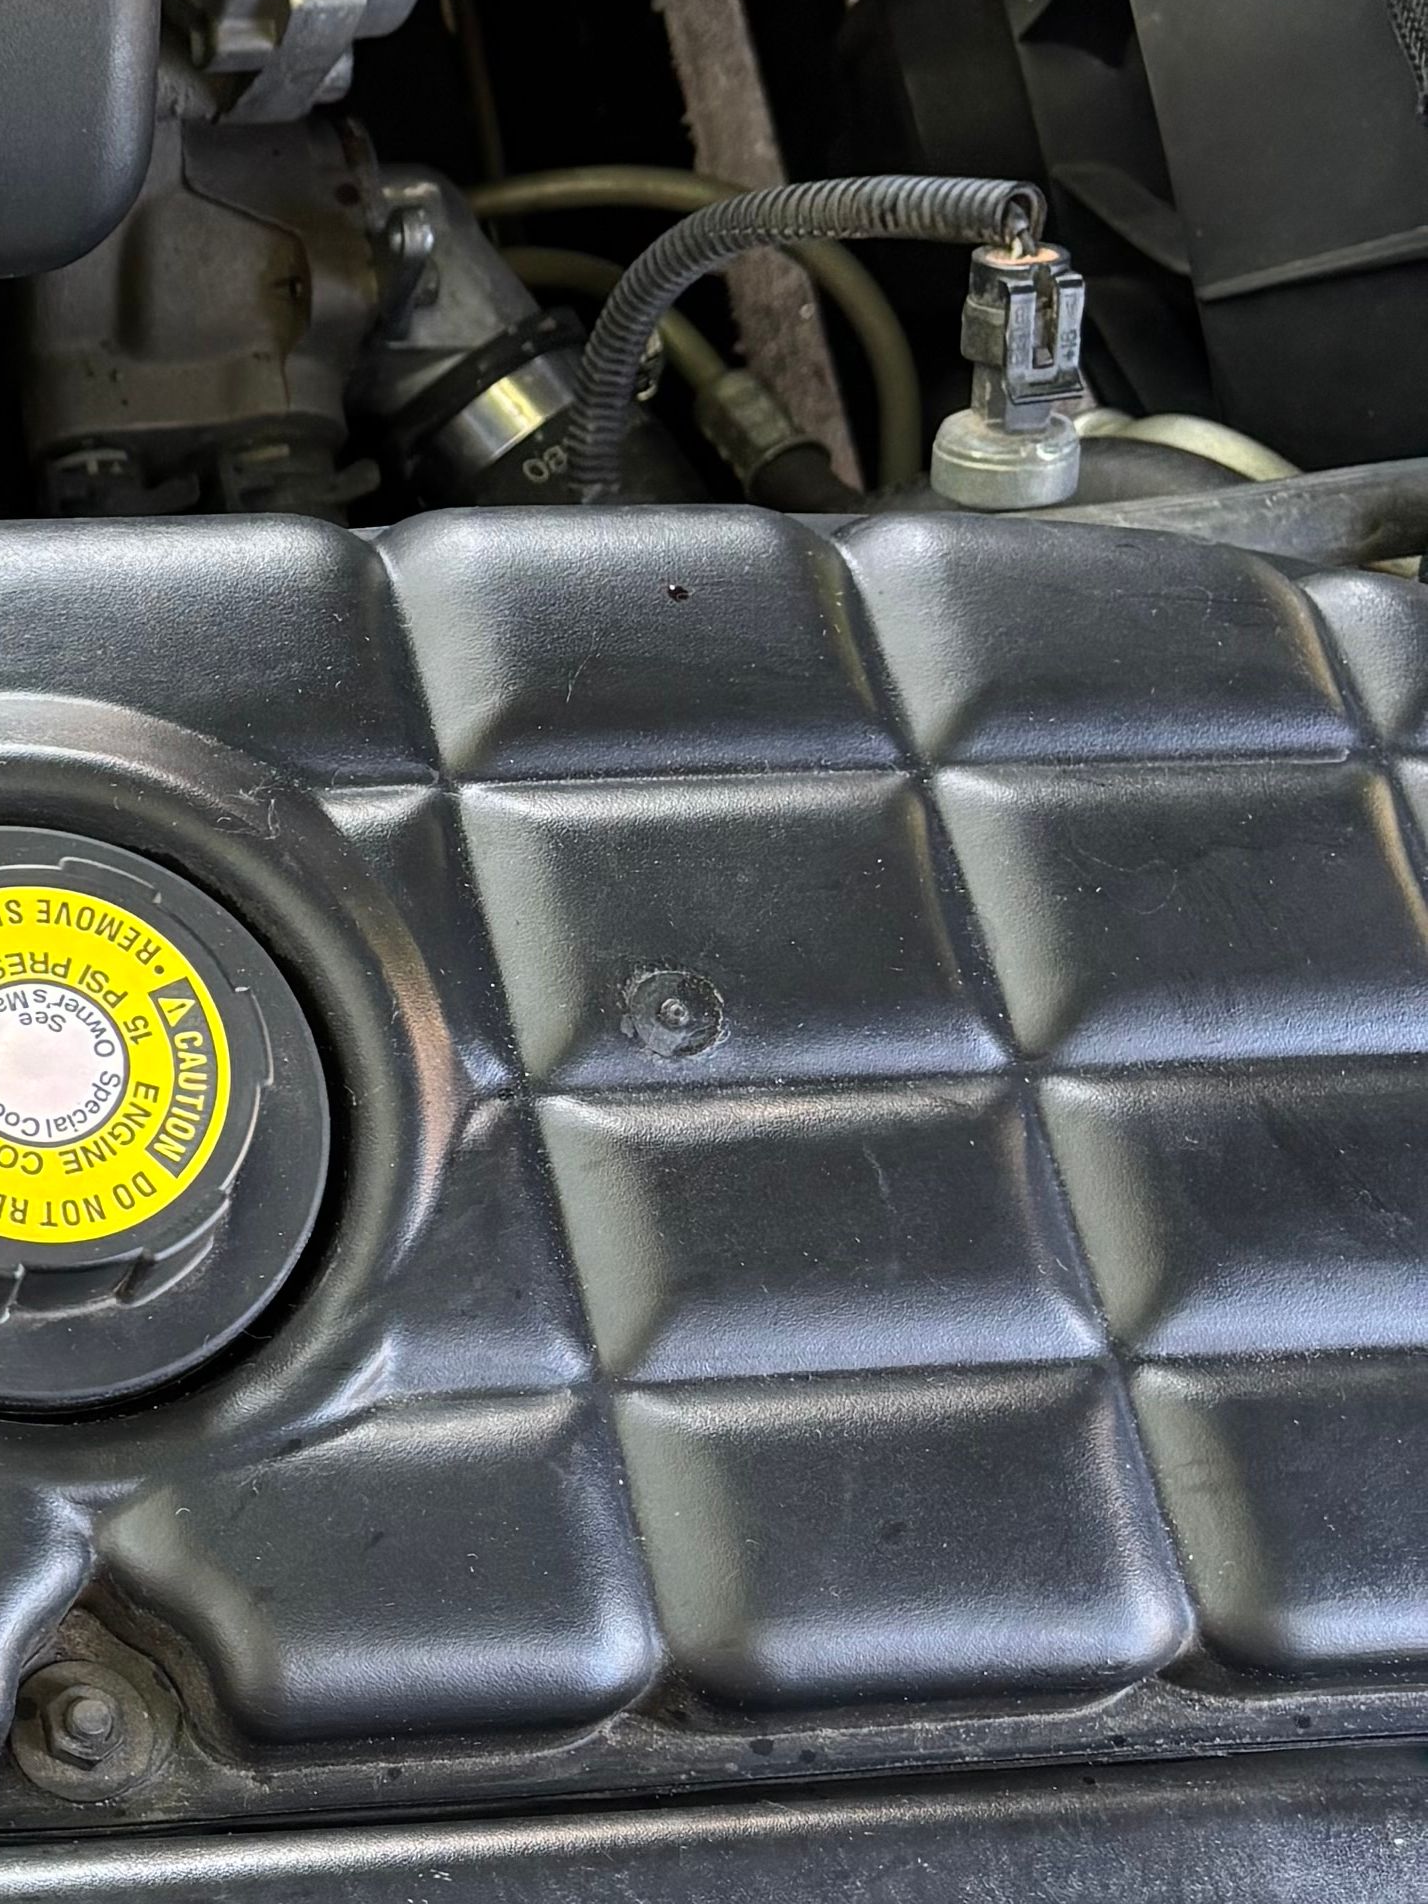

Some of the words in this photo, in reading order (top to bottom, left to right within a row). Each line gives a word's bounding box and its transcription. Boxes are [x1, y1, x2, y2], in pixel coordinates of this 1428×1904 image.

[36, 899, 163, 966] REMOVE
[77, 963, 129, 1009] PSI
[18, 1010, 68, 1033] See
[32, 988, 116, 1058] Owner's
[122, 1014, 153, 1045] 15
[45, 1070, 122, 1138] Special
[153, 1030, 208, 1163] CAUTION
[58, 1080, 161, 1175] ENGINE
[39, 1194, 107, 1228] NOT
[111, 1170, 158, 1211] DO
